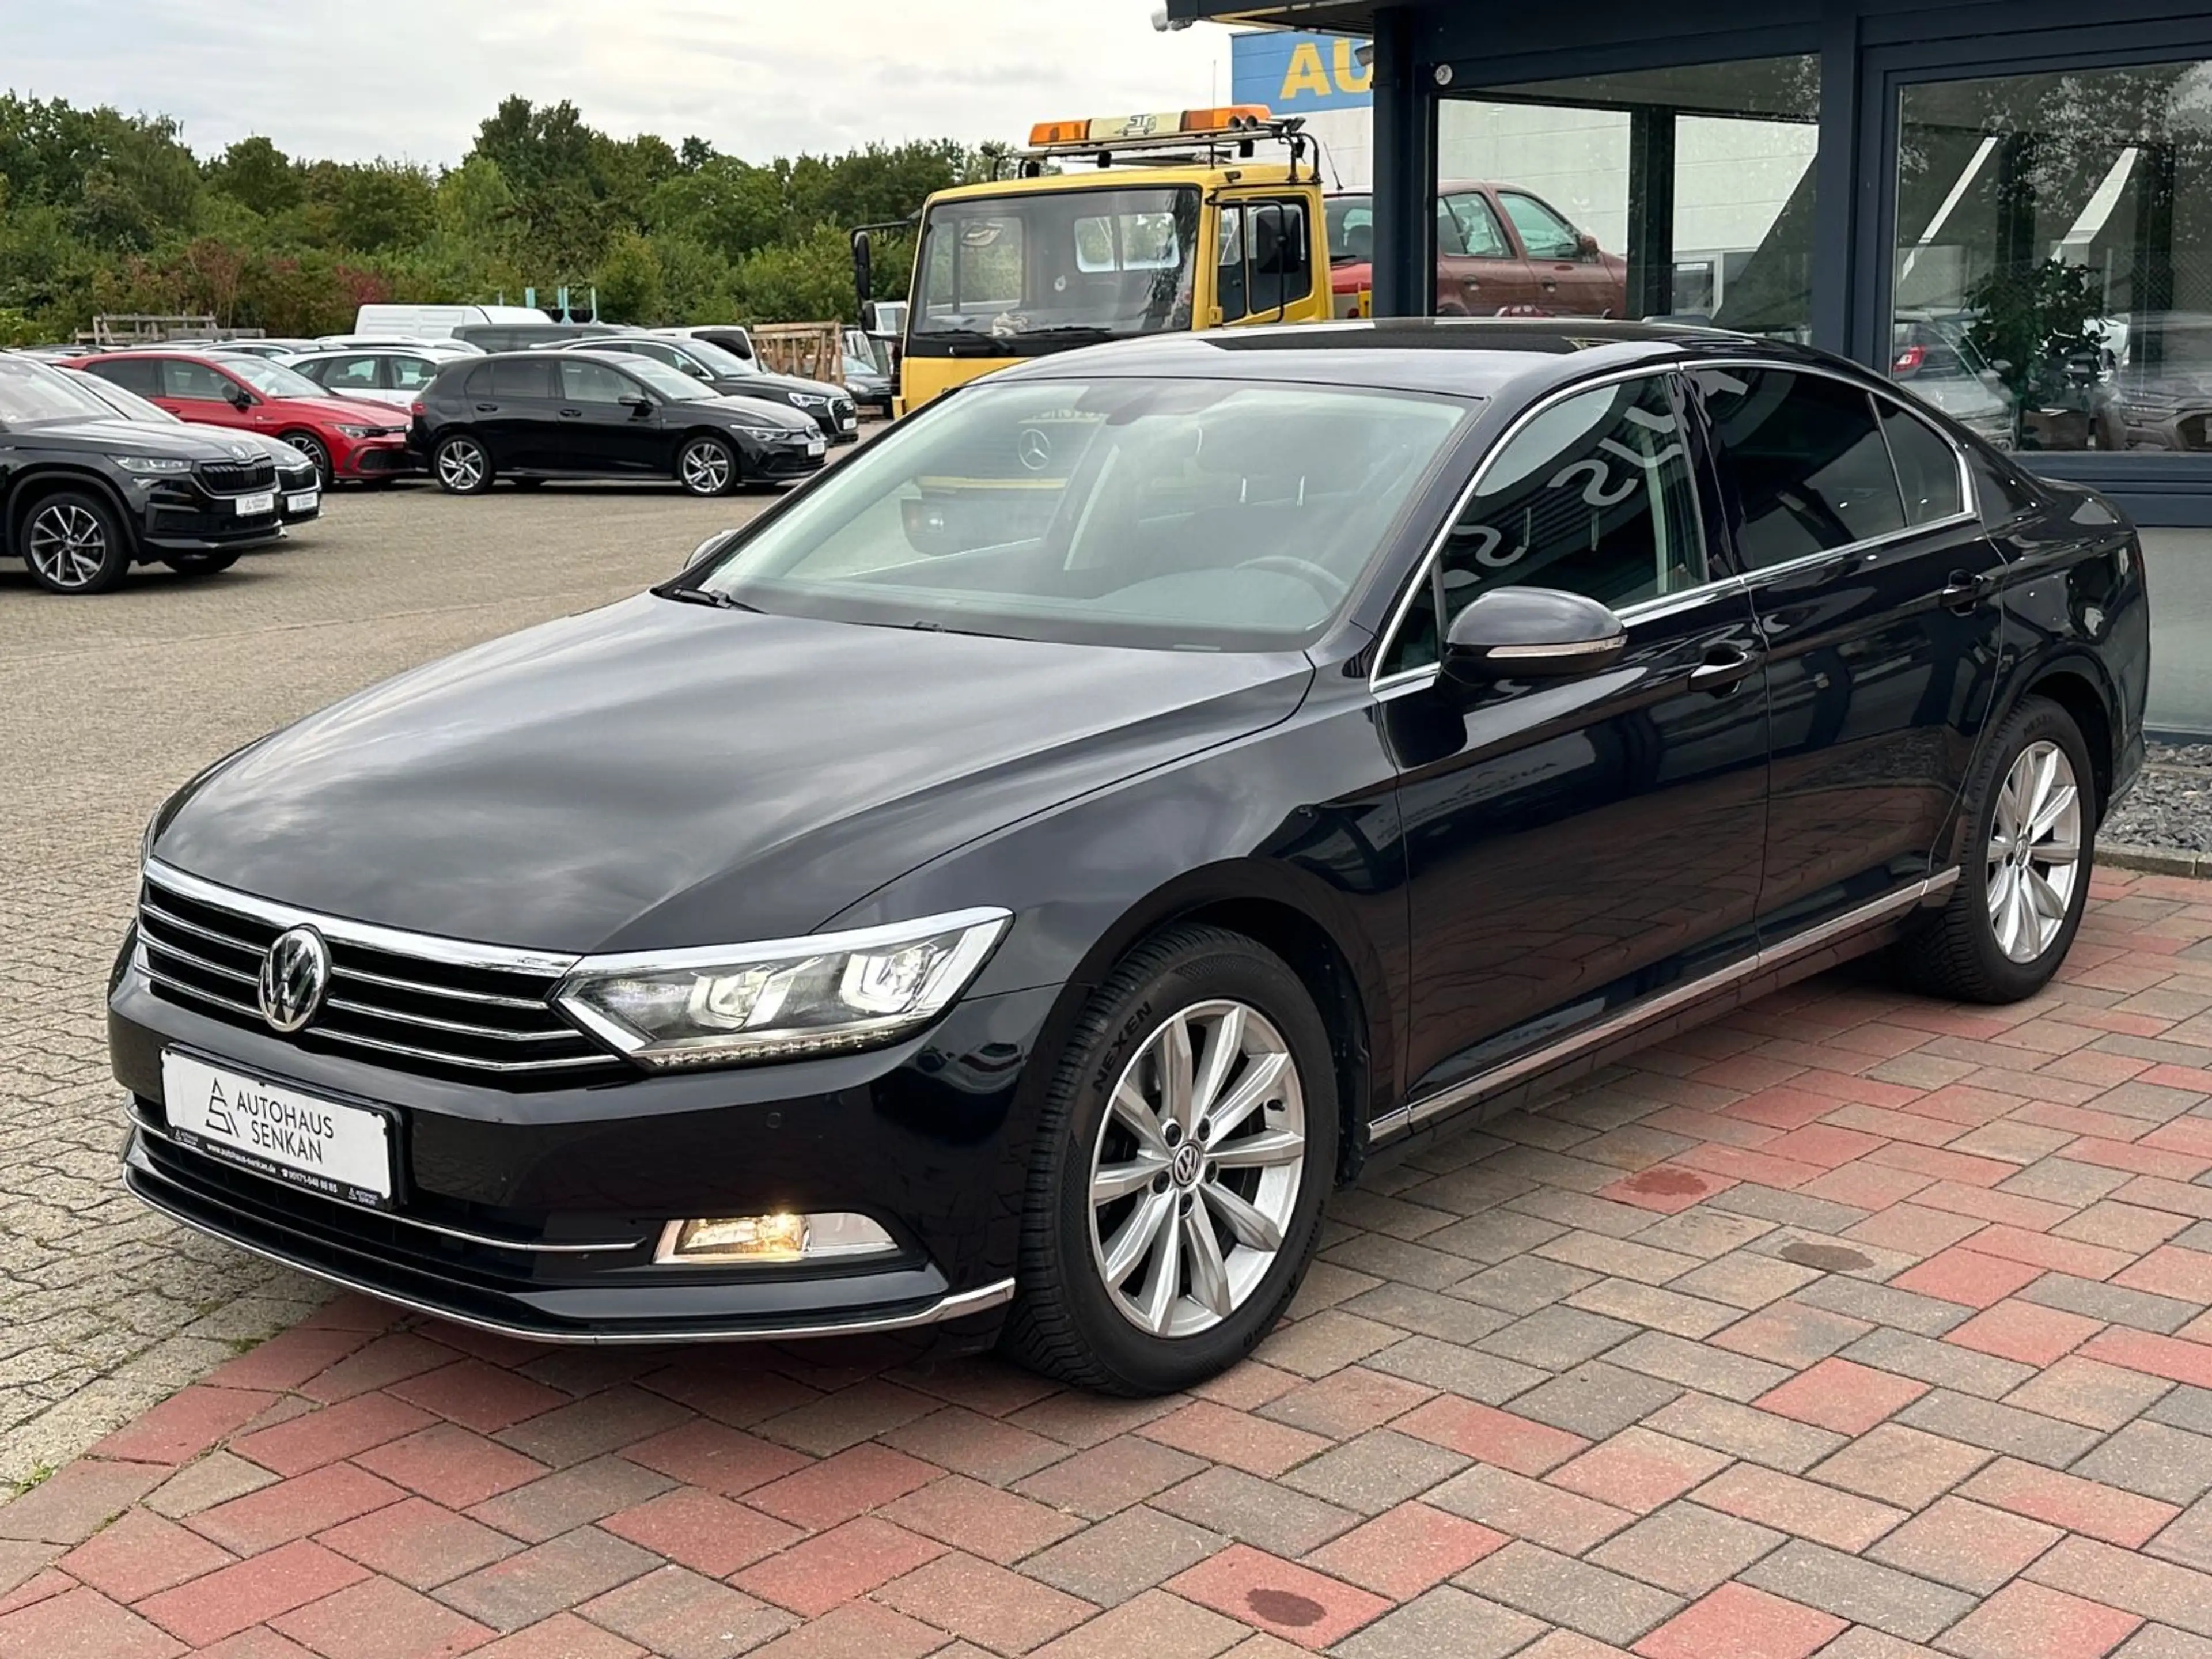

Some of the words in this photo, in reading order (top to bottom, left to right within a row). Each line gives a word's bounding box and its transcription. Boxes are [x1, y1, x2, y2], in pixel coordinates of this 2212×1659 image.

[1092, 1001, 1153, 1093] NEXEN
[237, 1090, 334, 1139] AUTOHAUS
[251, 1120, 323, 1164] SENKAN
